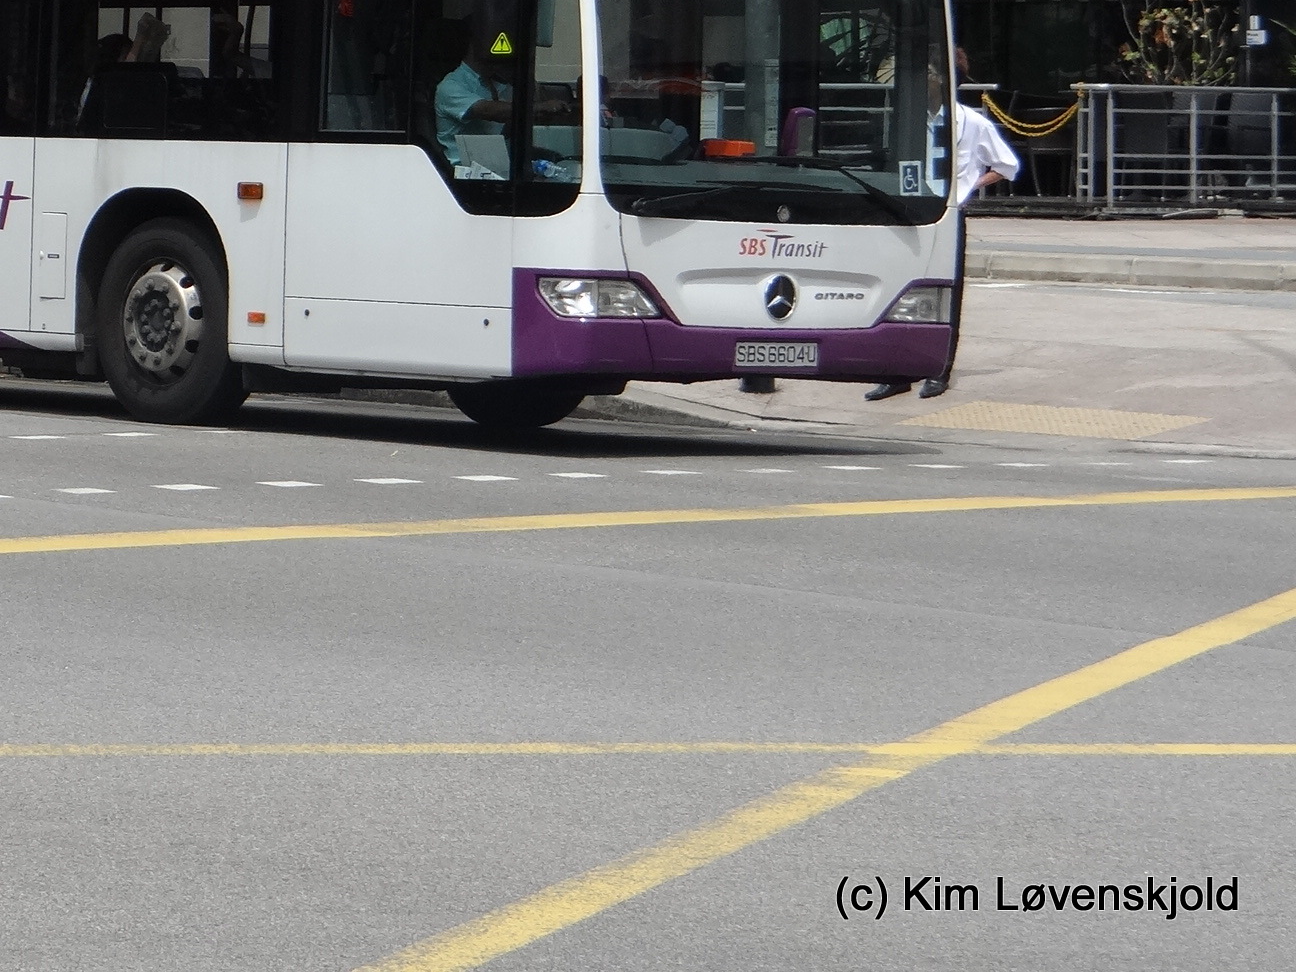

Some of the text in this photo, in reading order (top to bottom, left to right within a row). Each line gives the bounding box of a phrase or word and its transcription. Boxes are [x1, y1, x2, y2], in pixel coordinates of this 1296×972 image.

[739, 235, 828, 259] SBS Transit
[814, 292, 865, 300] CITARO
